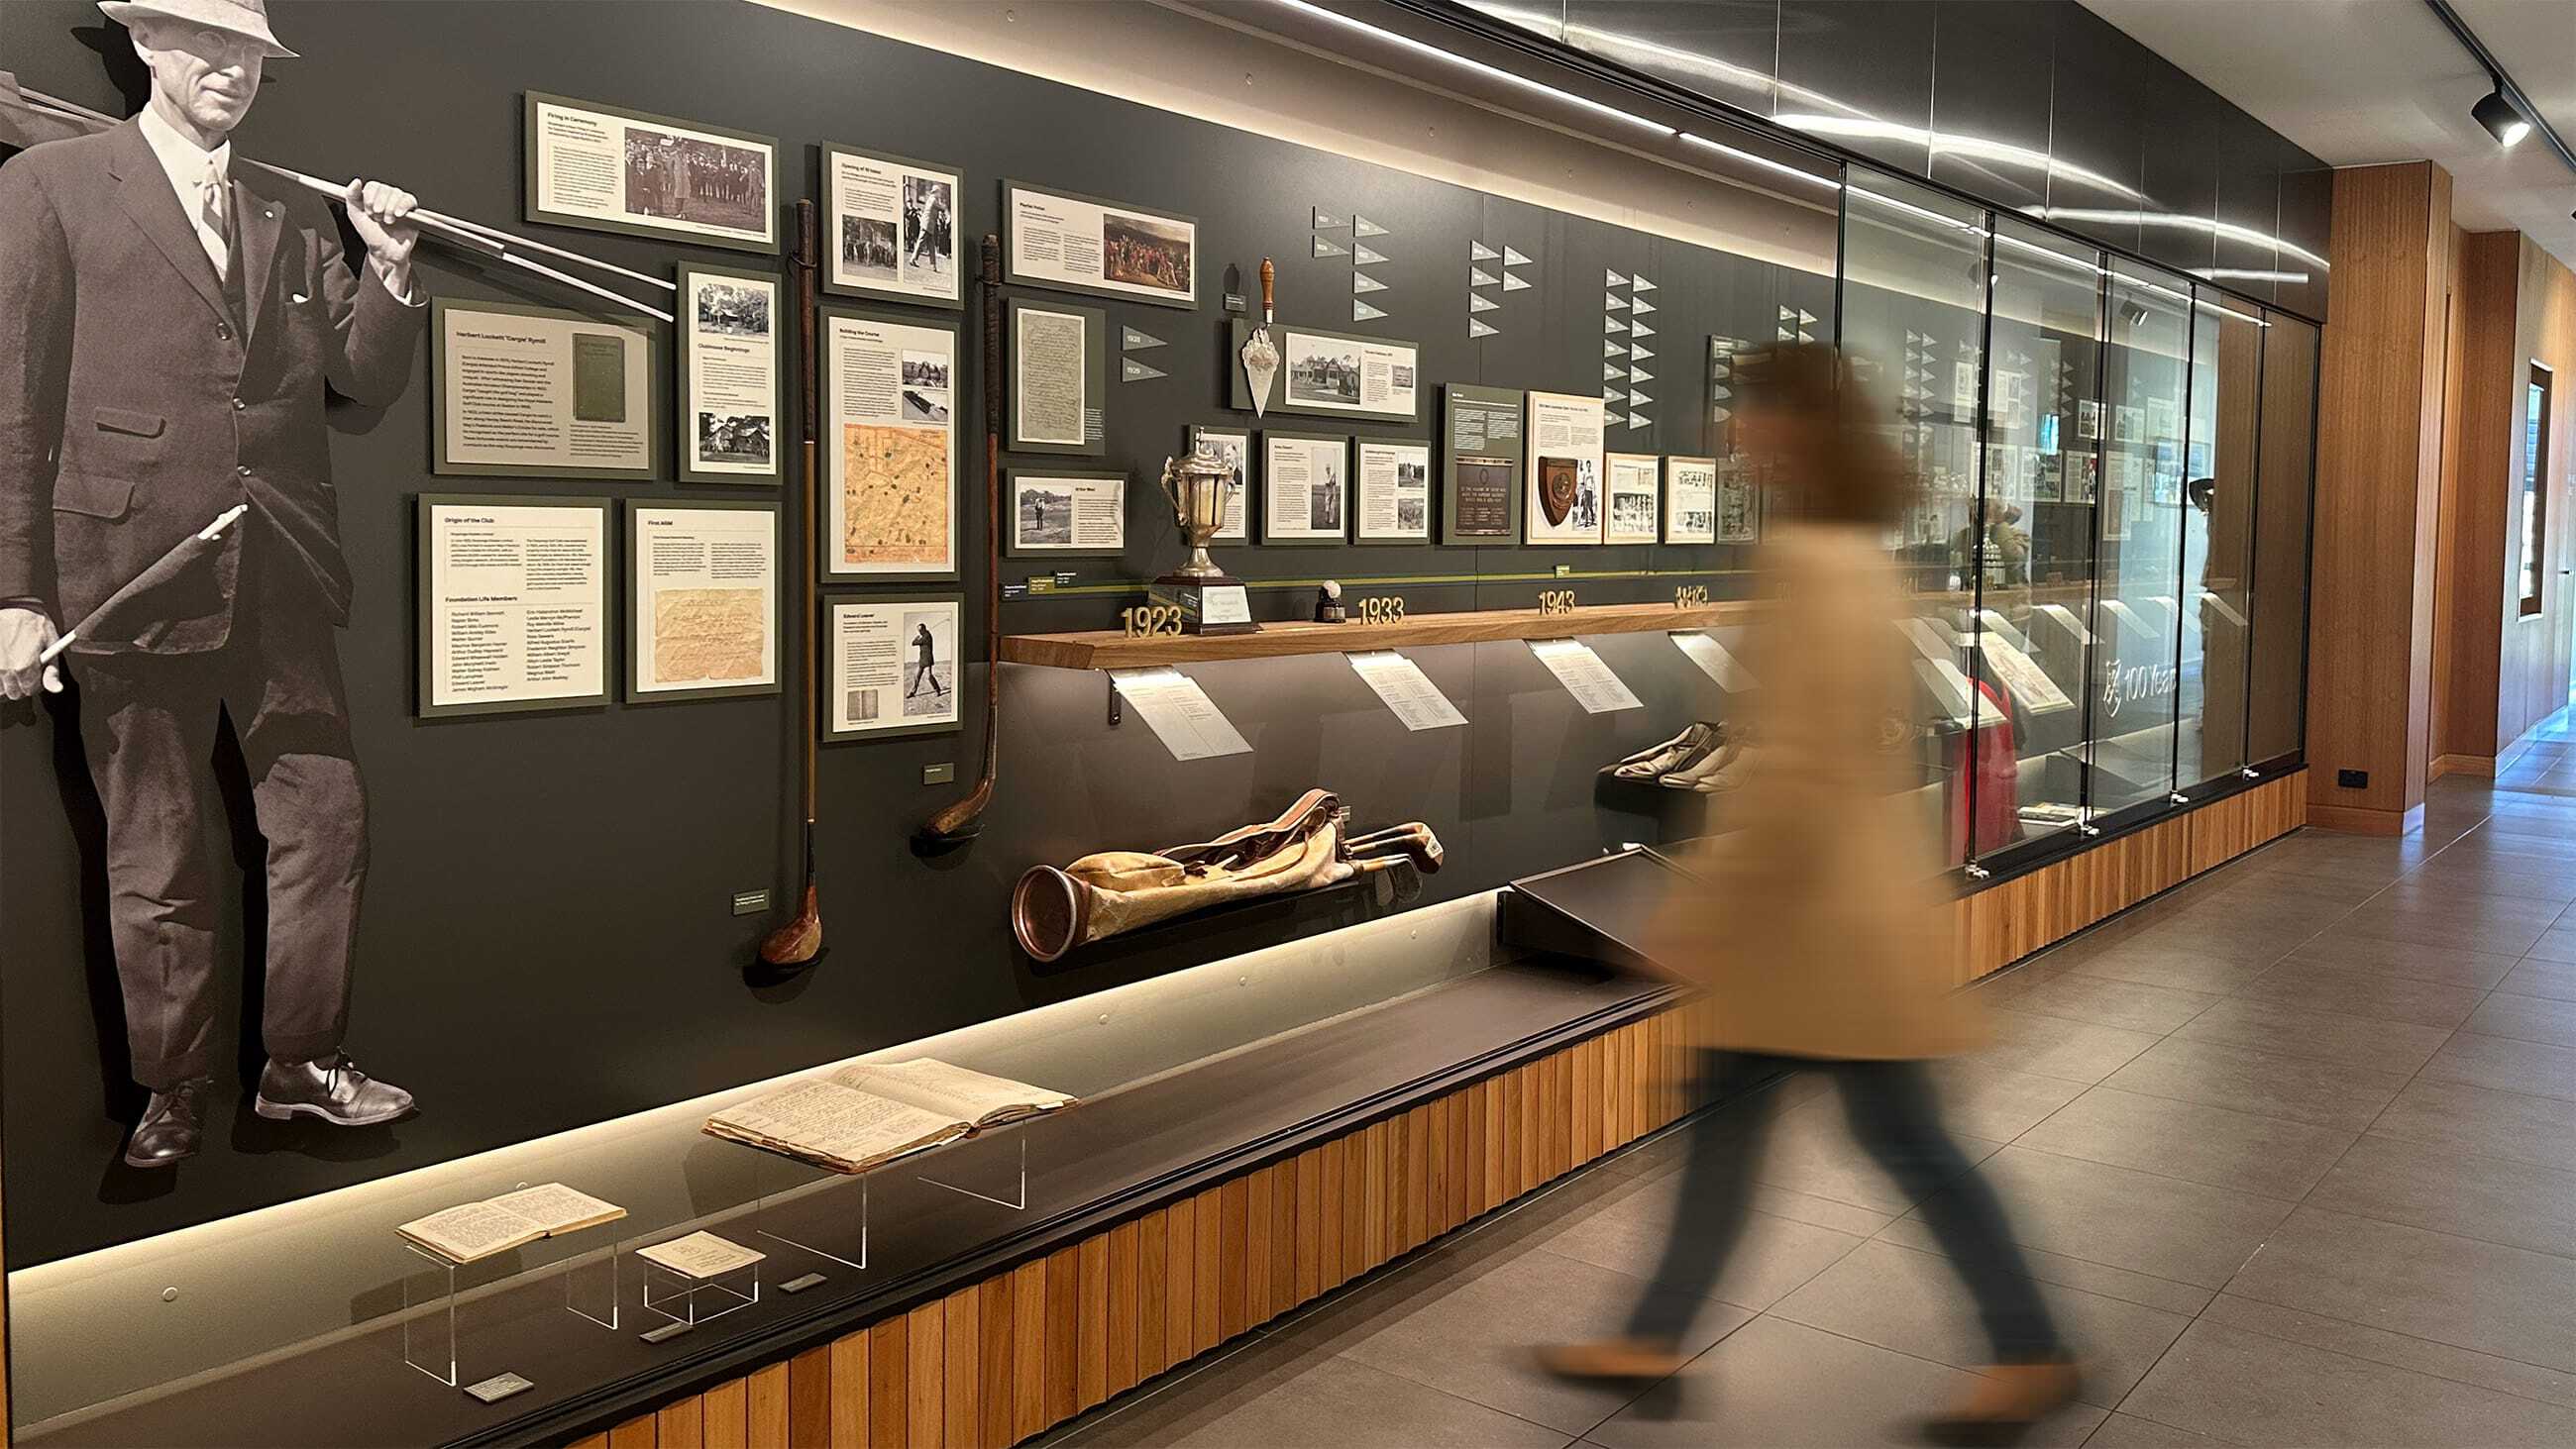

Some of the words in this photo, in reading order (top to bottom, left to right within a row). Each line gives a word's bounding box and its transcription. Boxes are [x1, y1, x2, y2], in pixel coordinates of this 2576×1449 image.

[1358, 596, 1404, 626] 1933
[1538, 590, 1575, 616] 1943
[1121, 606, 1182, 638] 1923
[2124, 666, 2147, 702] 100
